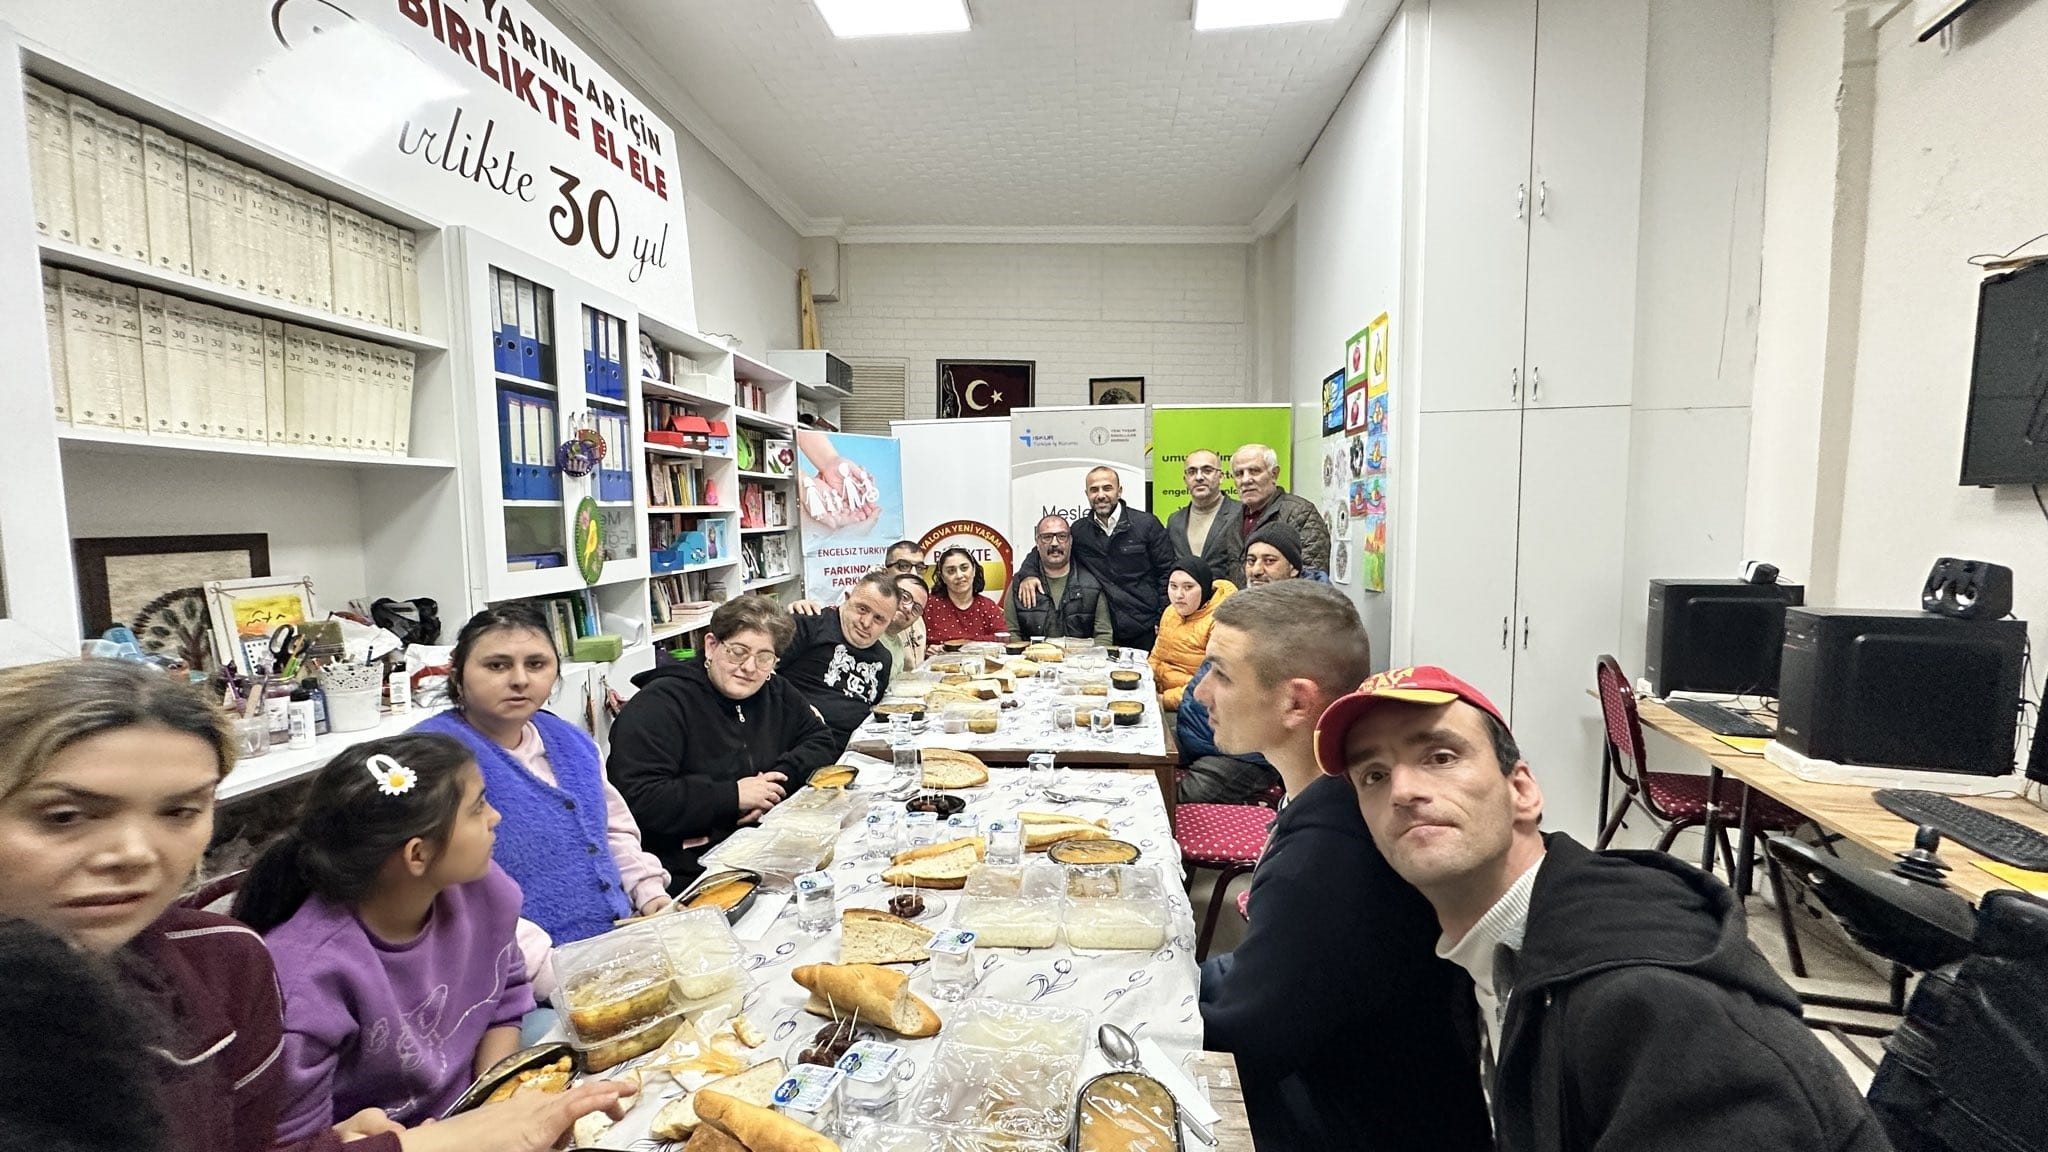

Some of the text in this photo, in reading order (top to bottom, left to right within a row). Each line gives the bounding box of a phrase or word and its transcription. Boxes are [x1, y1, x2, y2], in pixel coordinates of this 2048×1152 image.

[591, 117, 624, 171] EL
[627, 144, 668, 201] ELE
[398, 106, 536, 202] irlikte
[549, 165, 620, 260] 30
[1162, 488, 1197, 498] engel
[1042, 505, 1093, 521] Mesle
[920, 524, 1003, 551] YALOVA YENİ YAŞAM
